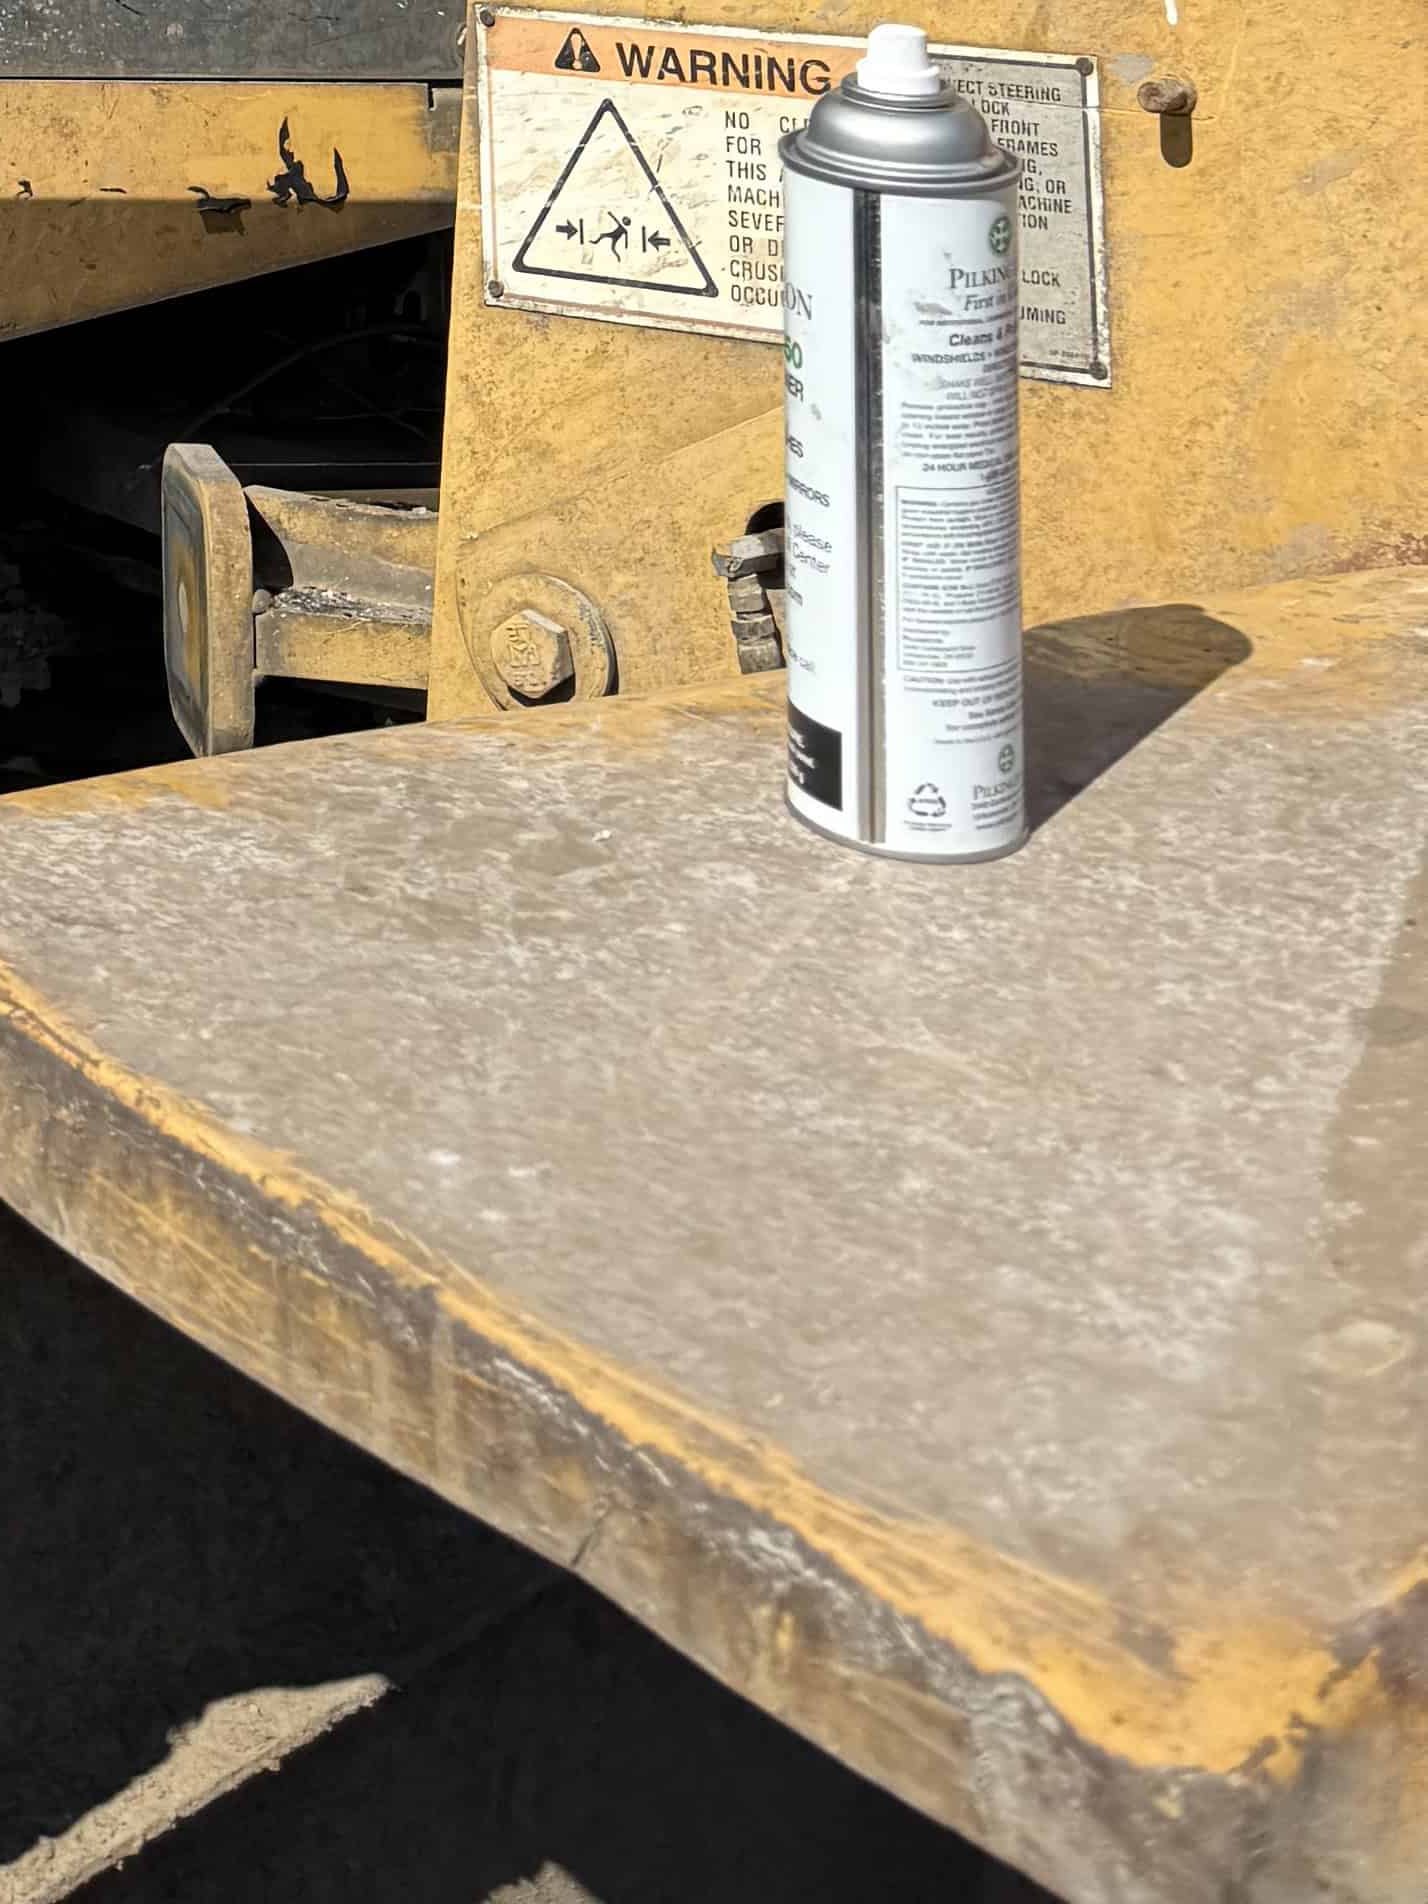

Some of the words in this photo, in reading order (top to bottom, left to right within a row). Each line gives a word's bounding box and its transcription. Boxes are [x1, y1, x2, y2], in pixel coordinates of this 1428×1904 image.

[615, 42, 832, 96] WARNING
[988, 82, 1061, 103] STEERING
[725, 110, 750, 130] NO
[991, 119, 1040, 137] FRONT
[726, 136, 761, 156] FOR
[997, 137, 1059, 157] FRAMES
[725, 160, 767, 181] THIS
[728, 184, 785, 209] MACH
[1046, 179, 1066, 195] OR
[729, 235, 753, 255] OR
[1021, 270, 1061, 289] LOCK
